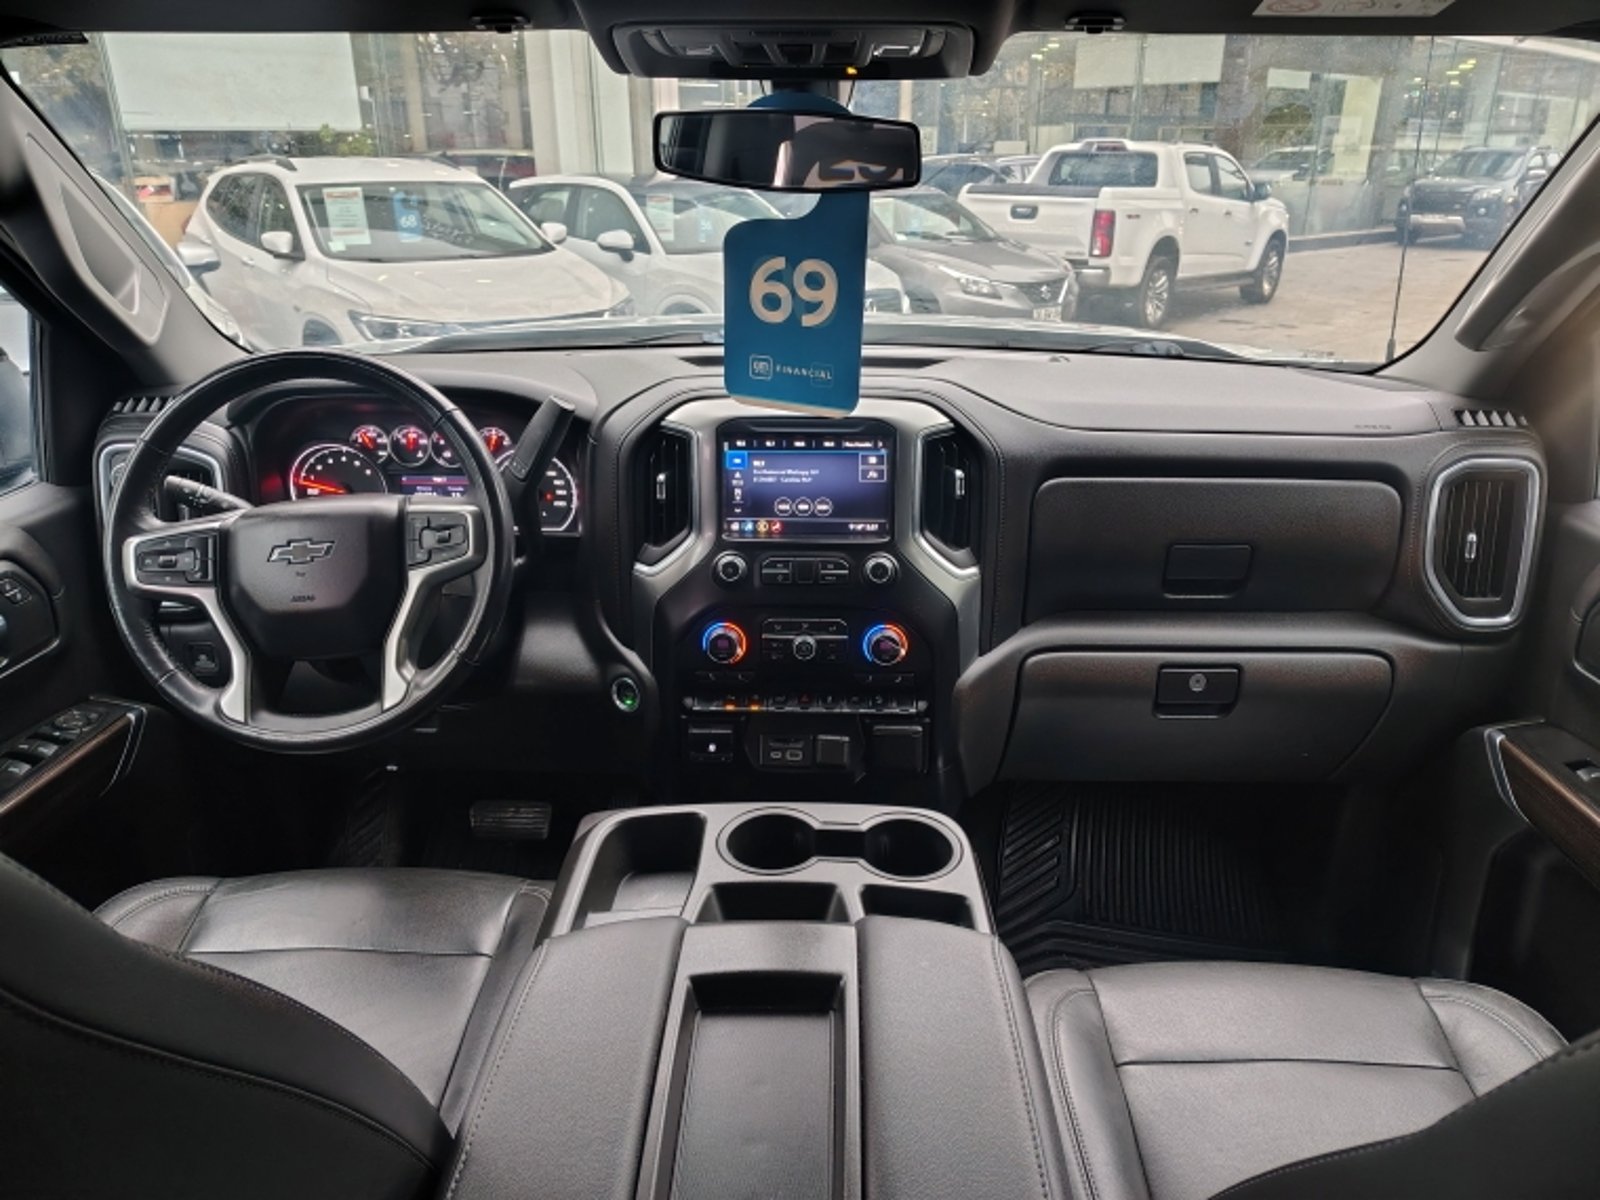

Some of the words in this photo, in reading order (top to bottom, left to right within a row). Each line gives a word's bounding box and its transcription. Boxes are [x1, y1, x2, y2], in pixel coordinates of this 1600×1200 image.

[400, 214, 418, 228] 68
[750, 256, 839, 328] 69
[775, 363, 833, 380] FINANCIAL
